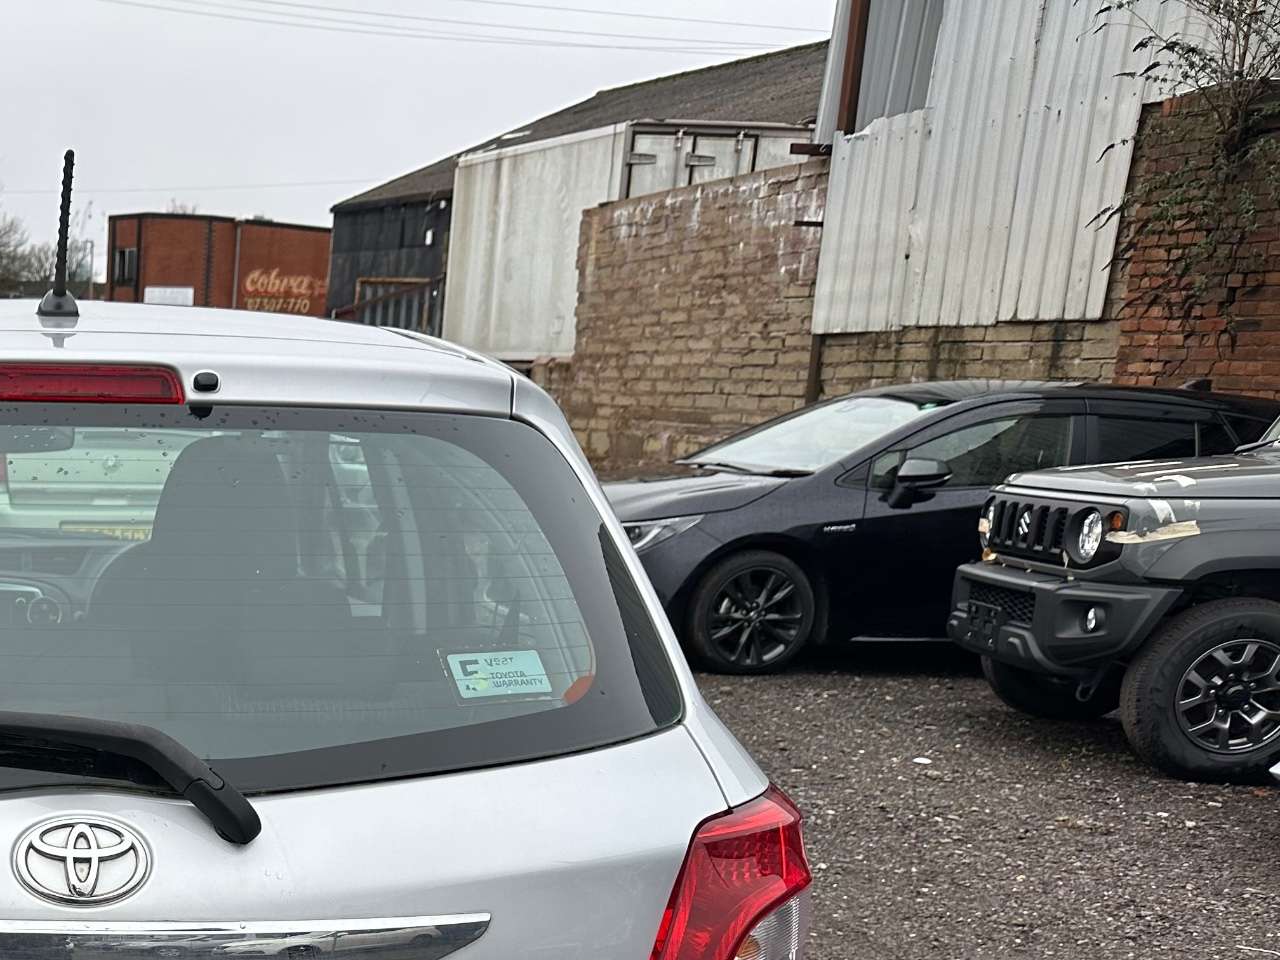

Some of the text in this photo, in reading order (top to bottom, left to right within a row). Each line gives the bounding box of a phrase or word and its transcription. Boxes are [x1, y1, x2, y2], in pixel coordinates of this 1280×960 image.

[245, 268, 311, 293] Cobra
[489, 670, 527, 679] TOYOTA
[493, 678, 544, 688] WARRANTY
